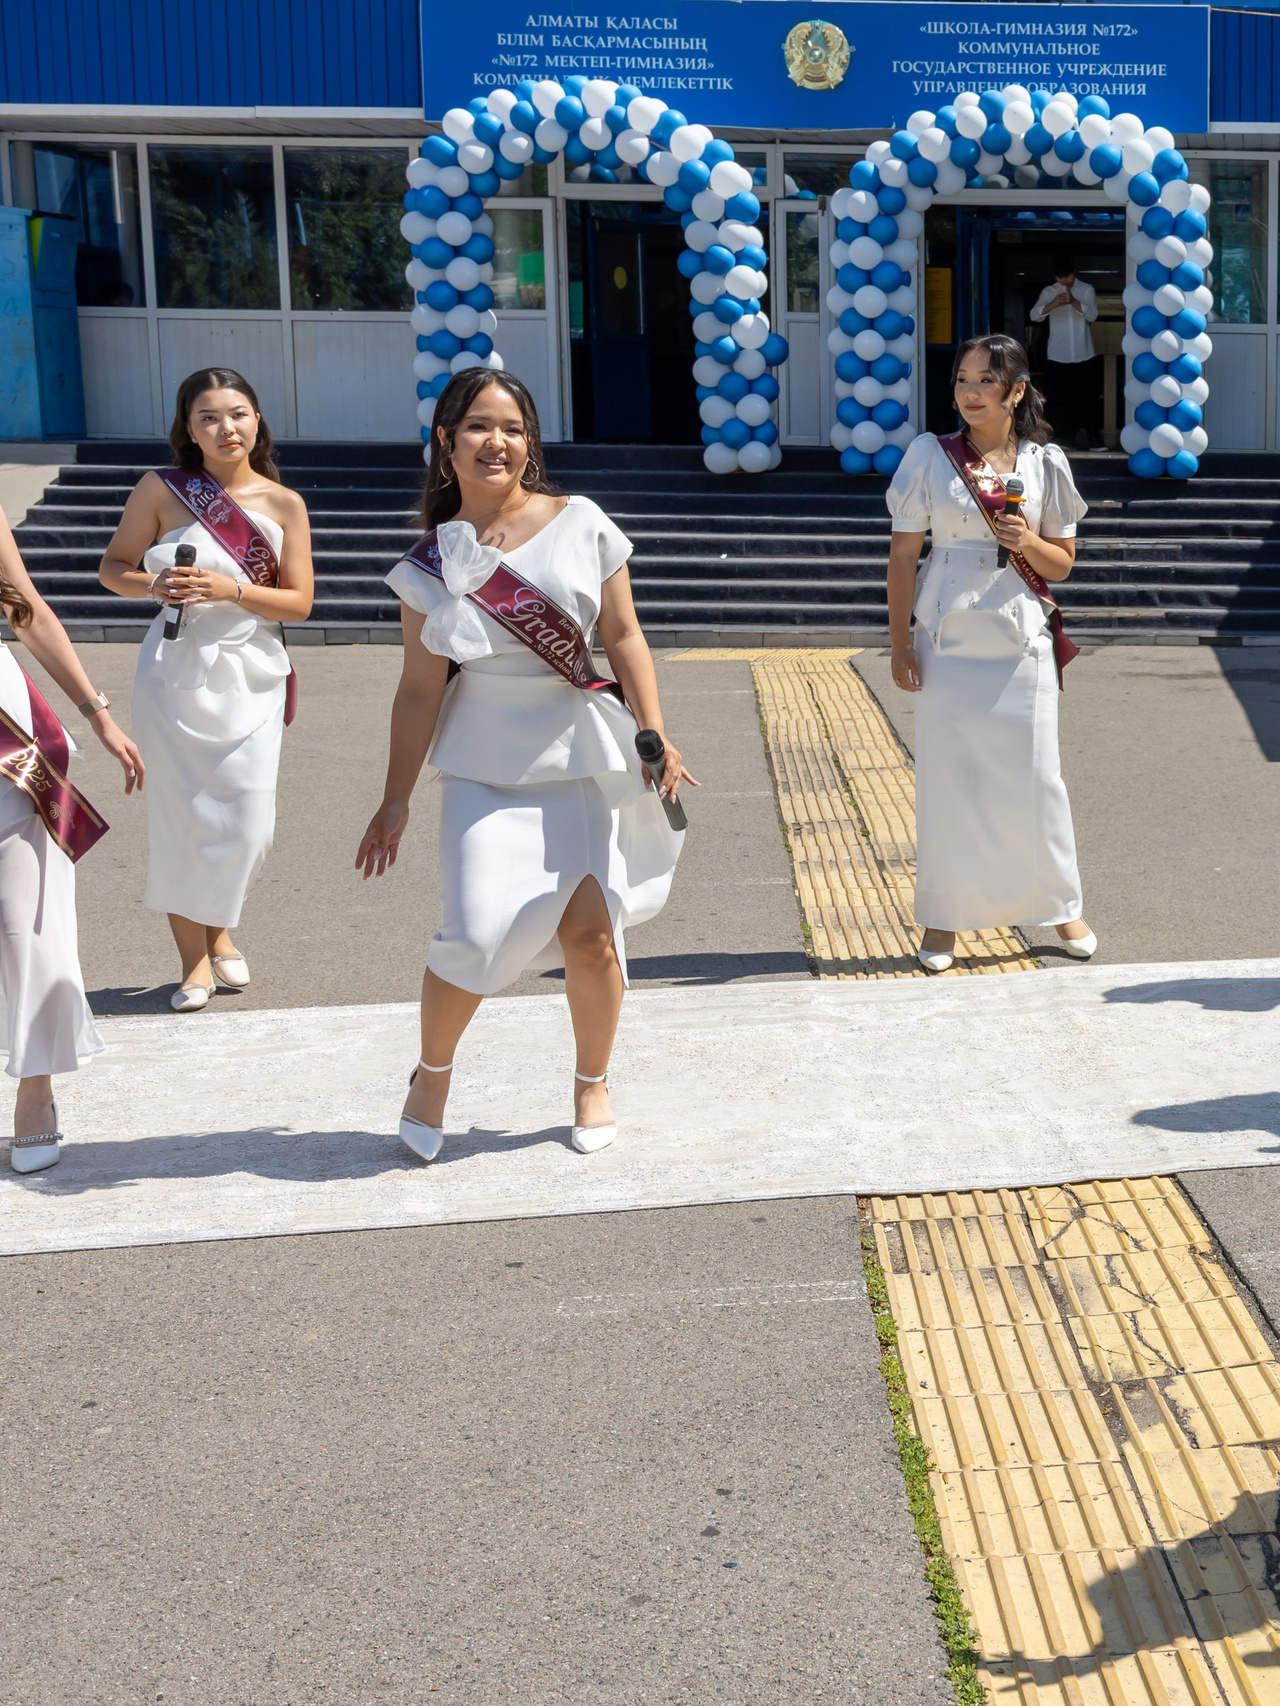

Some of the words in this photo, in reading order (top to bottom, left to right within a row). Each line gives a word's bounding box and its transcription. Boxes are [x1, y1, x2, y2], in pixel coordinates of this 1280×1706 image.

[526, 15, 598, 28] АЛМАТЫ
[606, 16, 678, 31] ҚАЛАСЫ
[920, 21, 1087, 36] «ШКОЛА-ГИМНАЗИЯ
[1092, 24, 1138, 37] №172»
[497, 33, 544, 46] БІЛІМ
[552, 34, 708, 52] БАСҚАРМАСЫНЫҢ
[958, 41, 1101, 57] КОММУНАЛЬНОЕ
[491, 54, 538, 67] «№172
[545, 55, 714, 70] МЕКТЕП-ГИМНАЗИЯ»
[892, 60, 1051, 77] ГОСУДАРСТВЕННОЕ
[1056, 62, 1167, 78] УЧРЕЖДЕНИЕ
[473, 73, 610, 86] КОММУНА
[618, 76, 734, 90] МЕМЛЕКЕТТІК
[1026, 82, 1147, 96] ОБРАЗОВАНИЯ
[497, 589, 588, 686] Graduate
[552, 658, 573, 676] school
[6, 749, 52, 792] 2025
